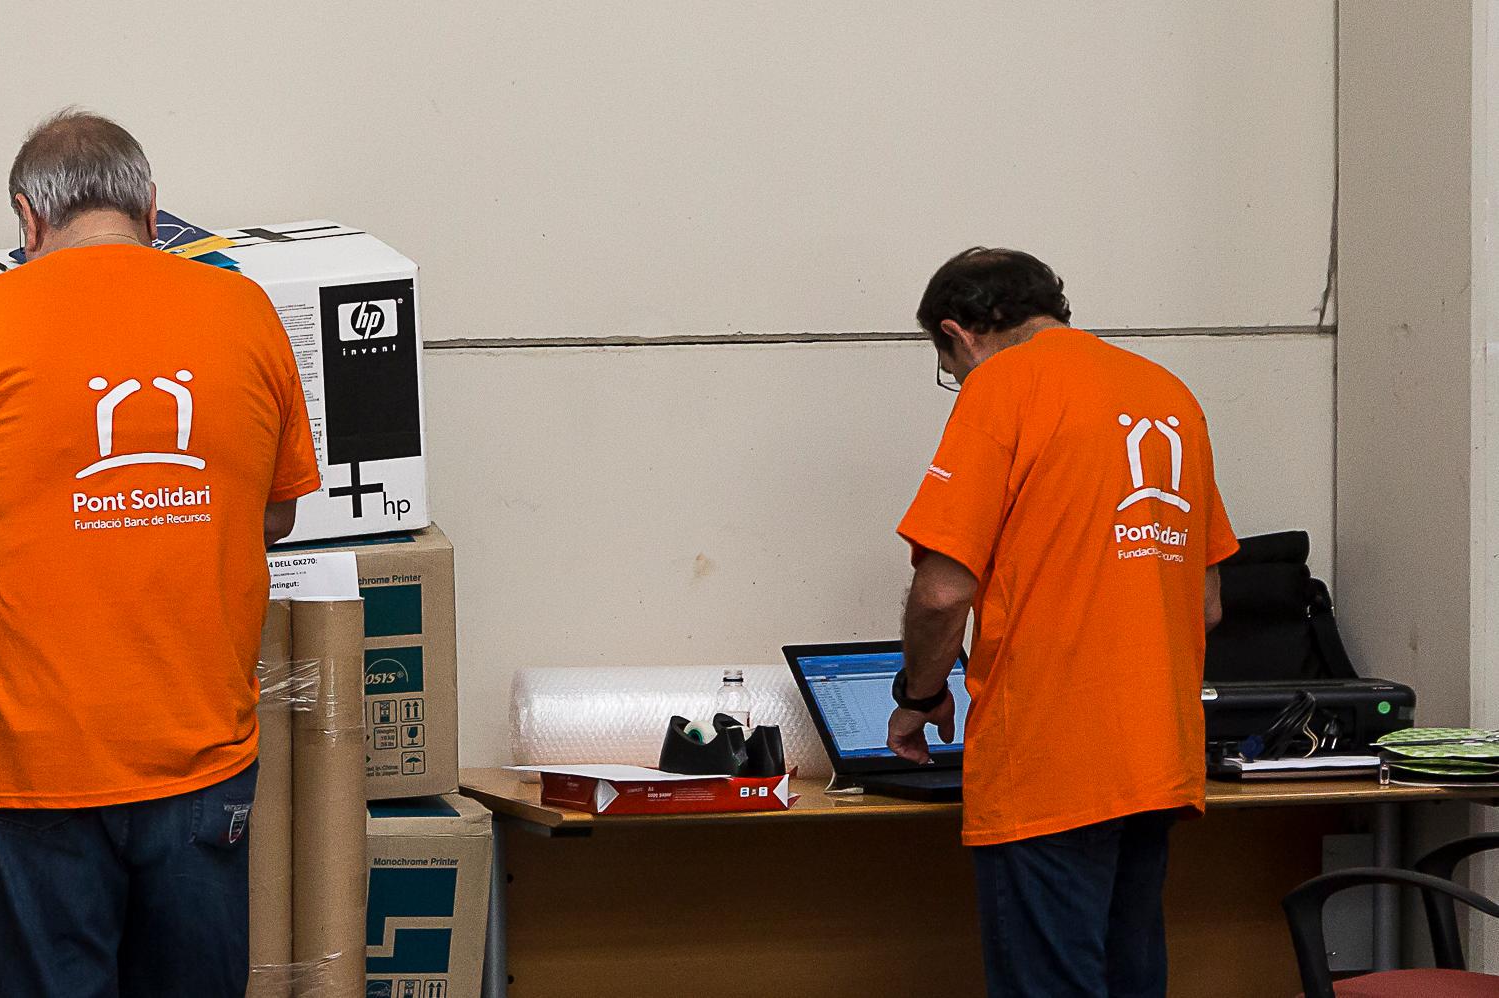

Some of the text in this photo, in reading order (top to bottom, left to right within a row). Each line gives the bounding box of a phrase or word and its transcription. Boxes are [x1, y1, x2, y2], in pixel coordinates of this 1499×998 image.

[342, 343, 397, 357] invent
[72, 485, 211, 513] Pont Solidari
[383, 491, 411, 521] hp
[74, 513, 211, 530] Fundació Banc de Recursos
[1114, 524, 1155, 544] Pon
[274, 560, 291, 568] DELL
[292, 557, 318, 567] GX270:
[270, 581, 300, 590] ntingut:
[358, 574, 422, 585] chrome Printer
[365, 672, 397, 685] OSYS
[373, 857, 460, 866] Monochrome Printer
